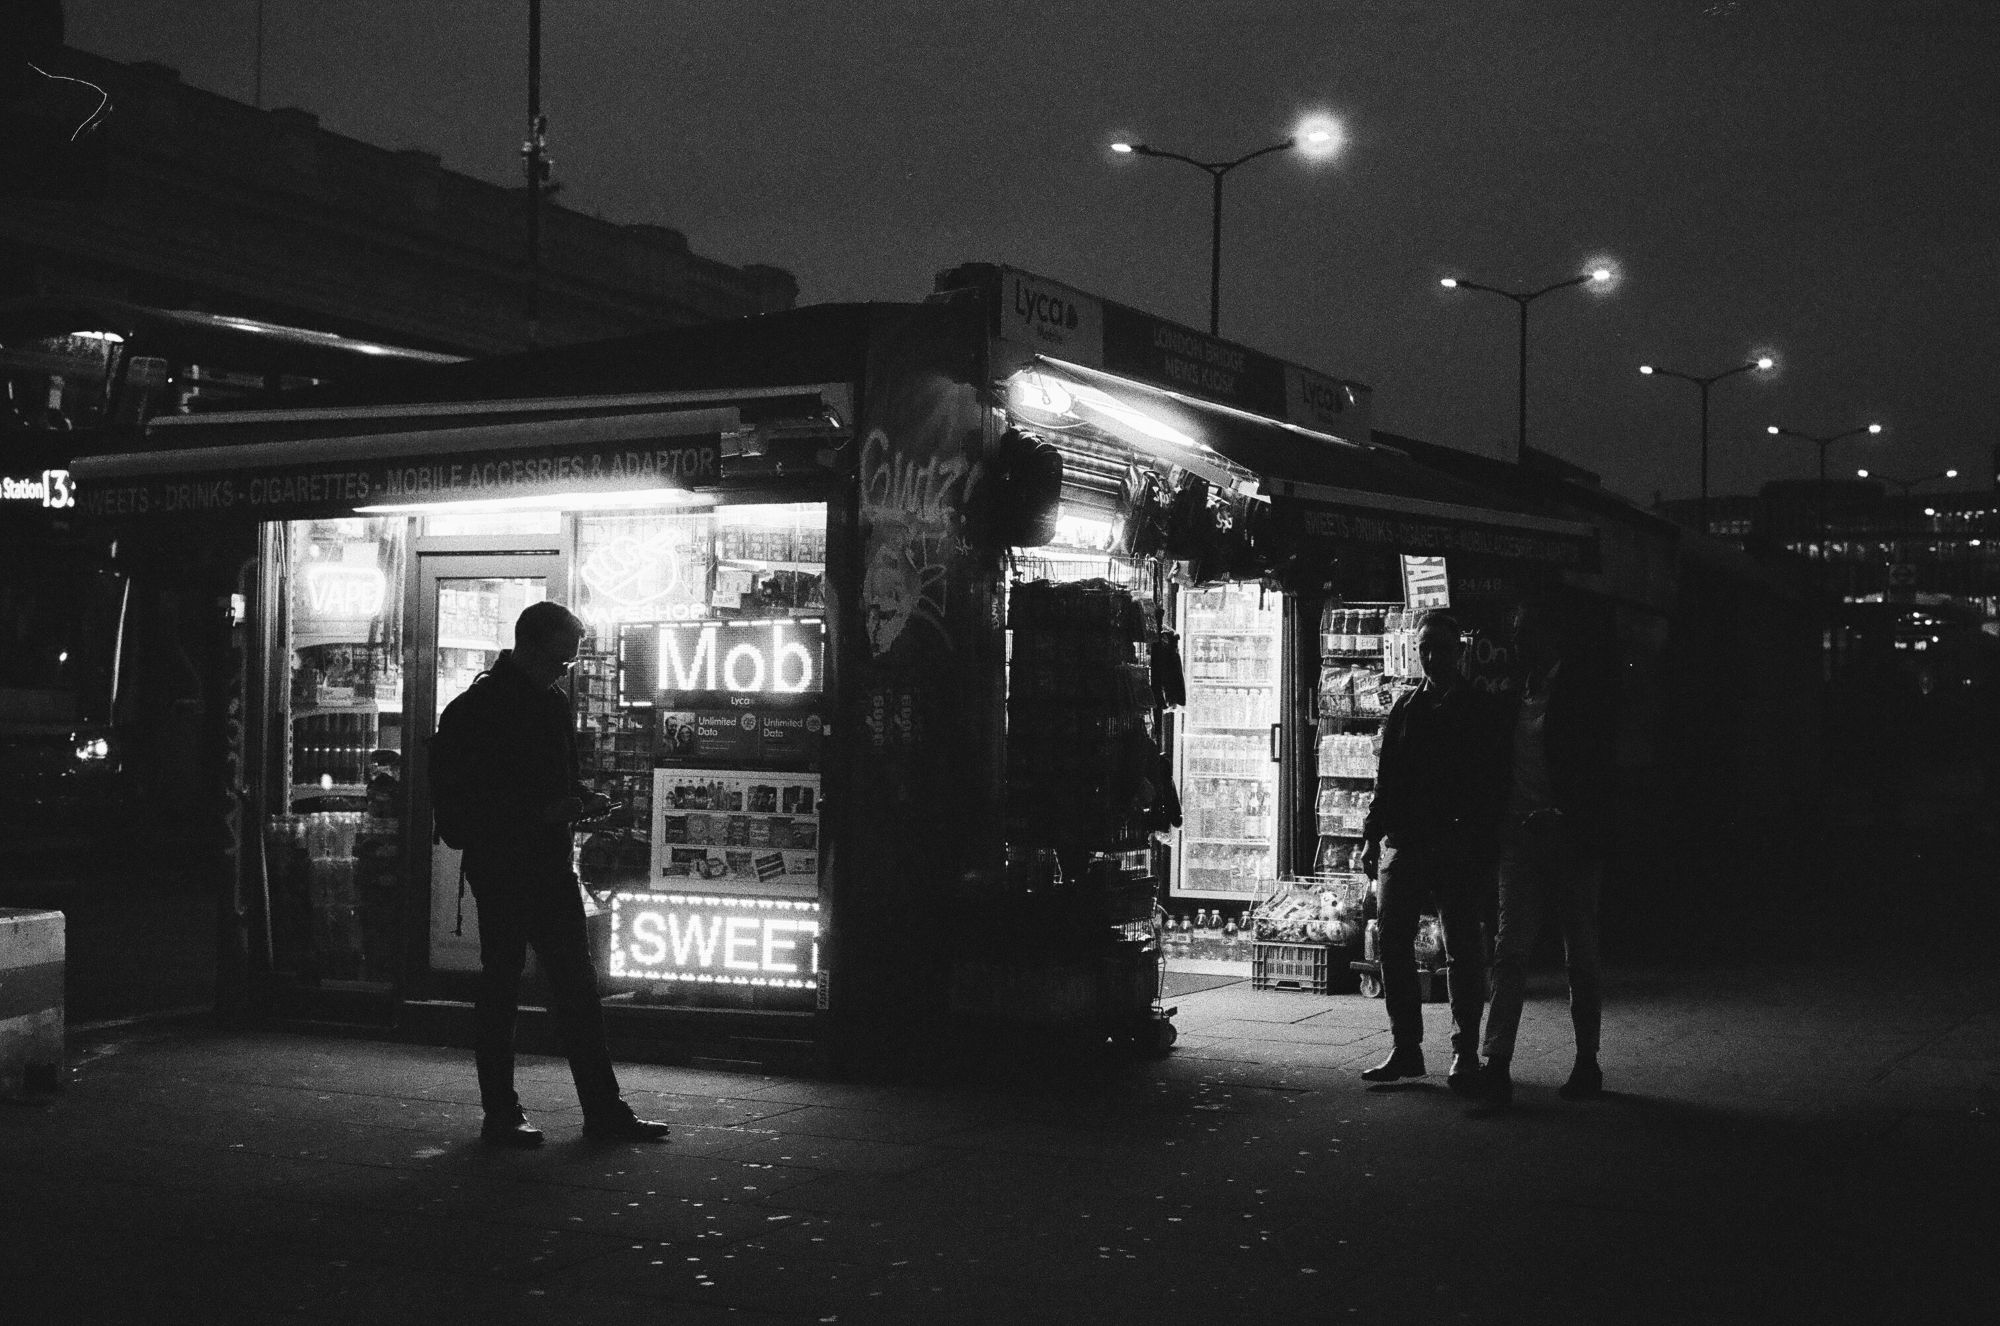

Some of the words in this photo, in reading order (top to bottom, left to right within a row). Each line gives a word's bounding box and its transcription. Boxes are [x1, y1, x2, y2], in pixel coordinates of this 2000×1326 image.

[1015, 279, 1063, 325] Lyca
[1153, 323, 1203, 359] LONDON
[1205, 341, 1246, 373] BRIDGE
[1164, 355, 1199, 385] NEWS
[1201, 367, 1236, 395] KIOSK
[3, 476, 43, 500] Station
[76, 486, 149, 516] SWEETS
[165, 480, 234, 511] DRINKS
[249, 472, 370, 504] CIGARETTES
[385, 463, 462, 496] MOBILE
[467, 455, 585, 490] ACCESRIES
[611, 447, 715, 477] ADAPTOR
[308, 579, 375, 615] VAPE
[1404, 555, 1447, 608] SALE
[658, 624, 813, 692] Mob
[730, 696, 750, 707] Lyca
[698, 716, 737, 727] Unlimited
[698, 727, 718, 736] Data
[763, 717, 803, 728] Unlimited
[763, 728, 784, 738] Data
